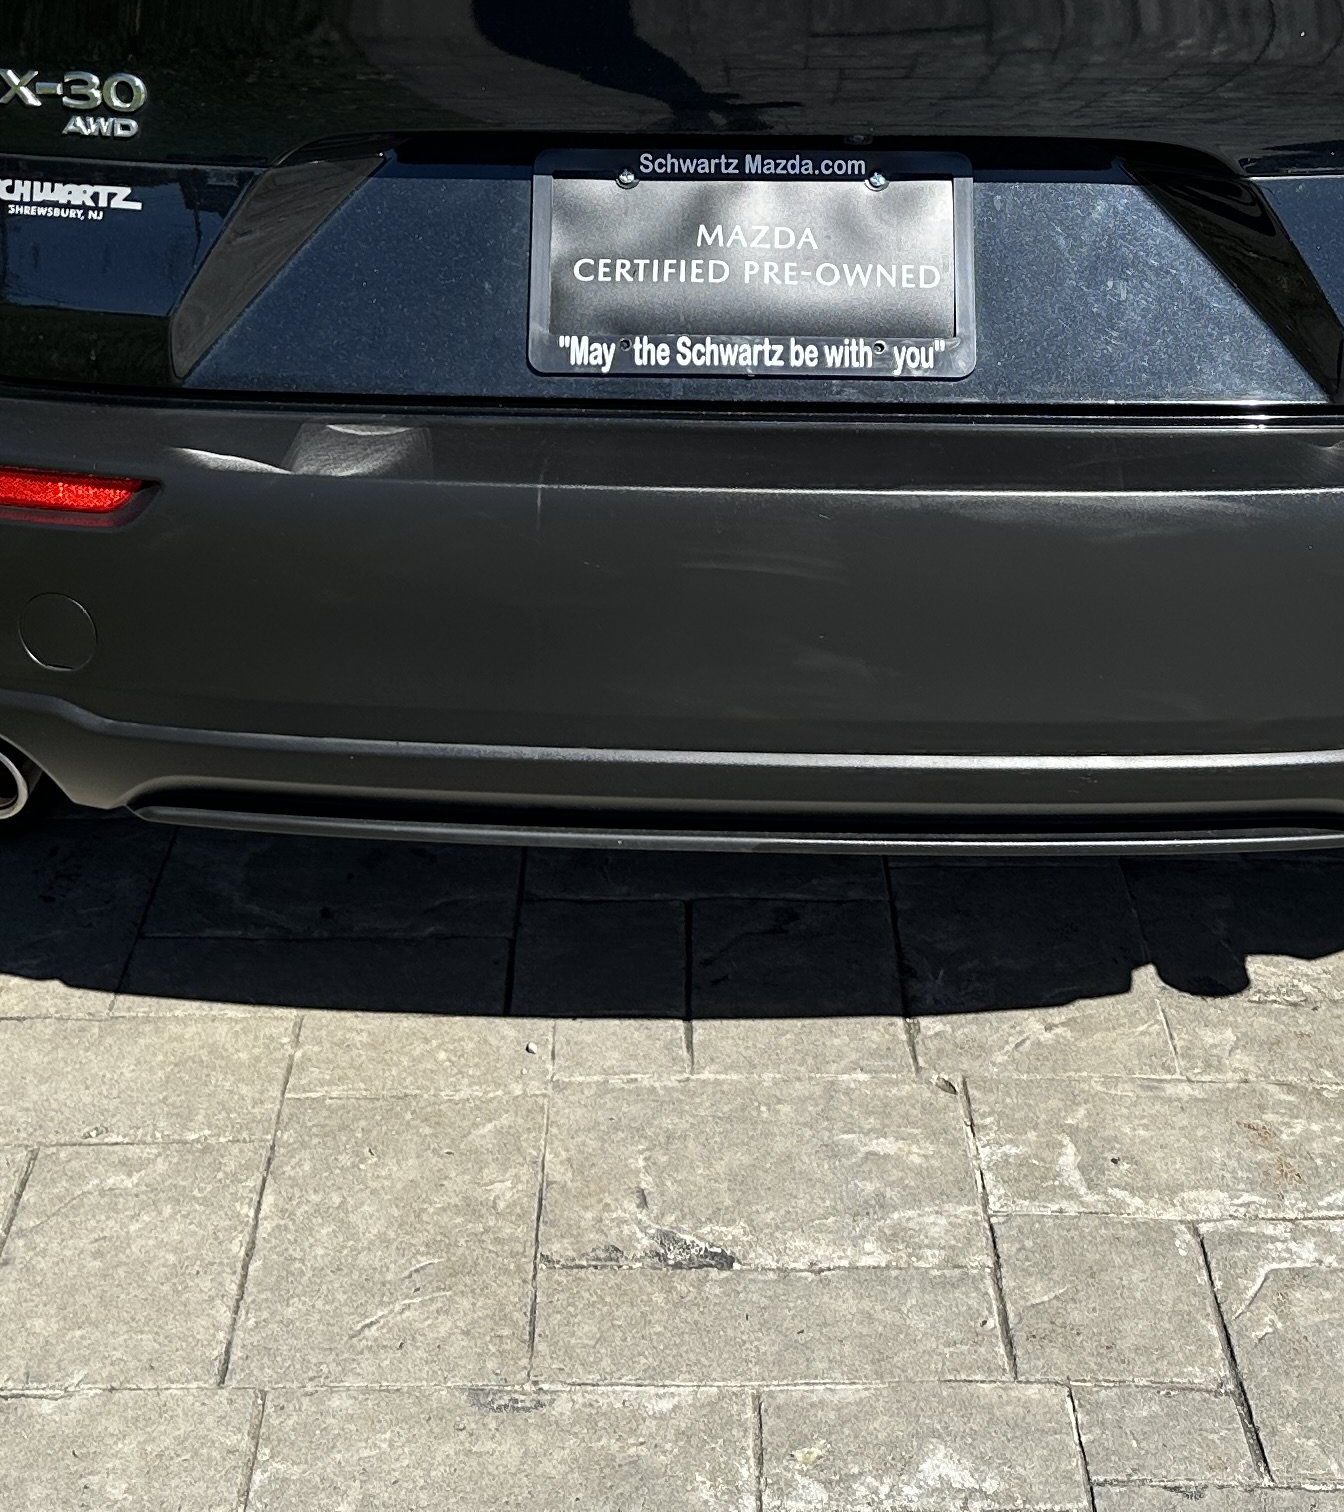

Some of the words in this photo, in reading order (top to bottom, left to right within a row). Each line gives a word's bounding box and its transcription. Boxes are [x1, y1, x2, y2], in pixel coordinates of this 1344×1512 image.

[62, 115, 139, 138] AWD
[639, 153, 739, 175] Schwartz
[745, 154, 866, 175] Mazda.com
[8, 204, 85, 221] SHREWSBURY,
[88, 212, 104, 220] NJ
[696, 224, 818, 250] MAZDA
[573, 258, 731, 284] CERTIFIED
[744, 261, 941, 289] PRE-OWNED
[559, 335, 616, 373] "May
[633, 335, 671, 366] the
[676, 336, 785, 367] Schwartz
[790, 337, 819, 368] be
[824, 338, 873, 368] with
[893, 339, 946, 377] you"
